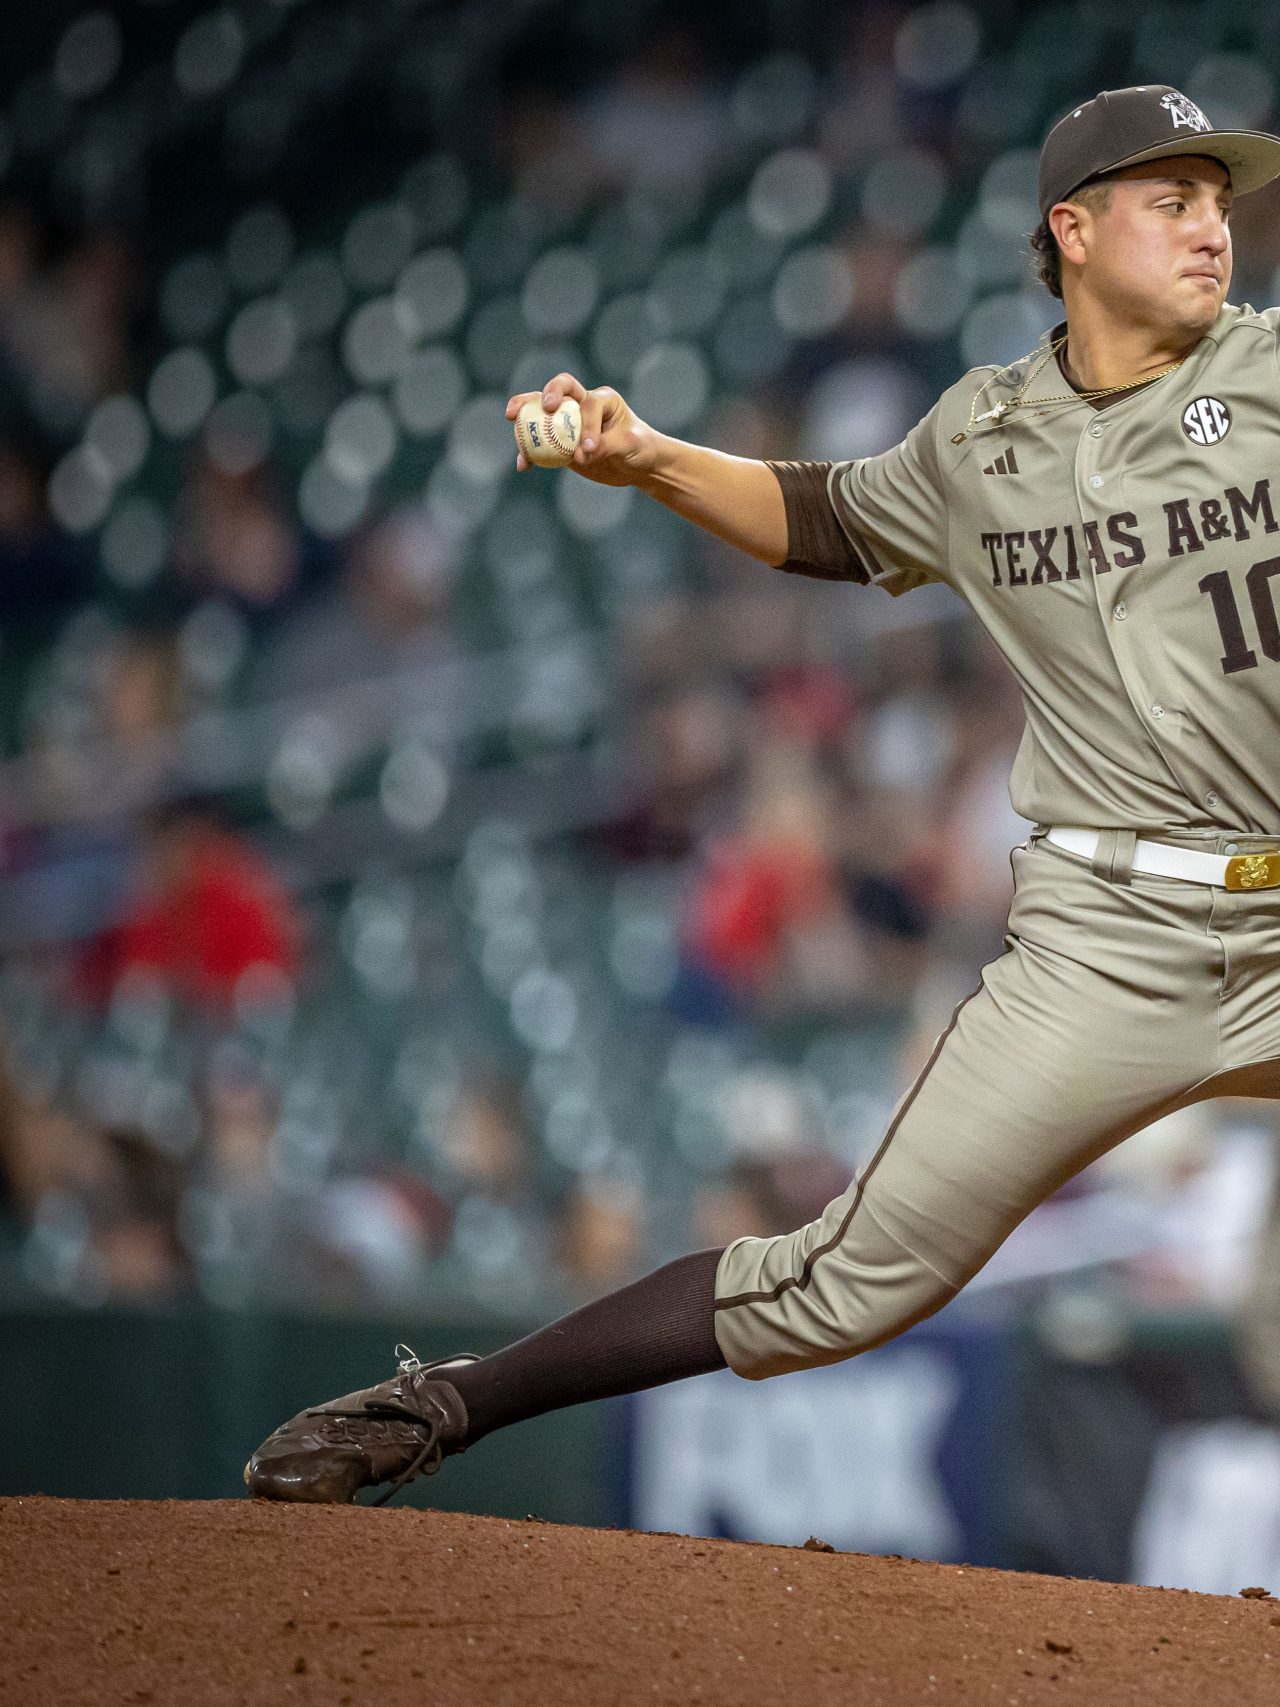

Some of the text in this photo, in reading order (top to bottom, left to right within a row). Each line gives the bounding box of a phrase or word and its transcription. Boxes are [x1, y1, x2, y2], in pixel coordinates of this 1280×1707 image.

[528, 420, 541, 448] NCAA
[1183, 397, 1231, 444] SEC
[981, 478, 1280, 587] TEXAS A&M
